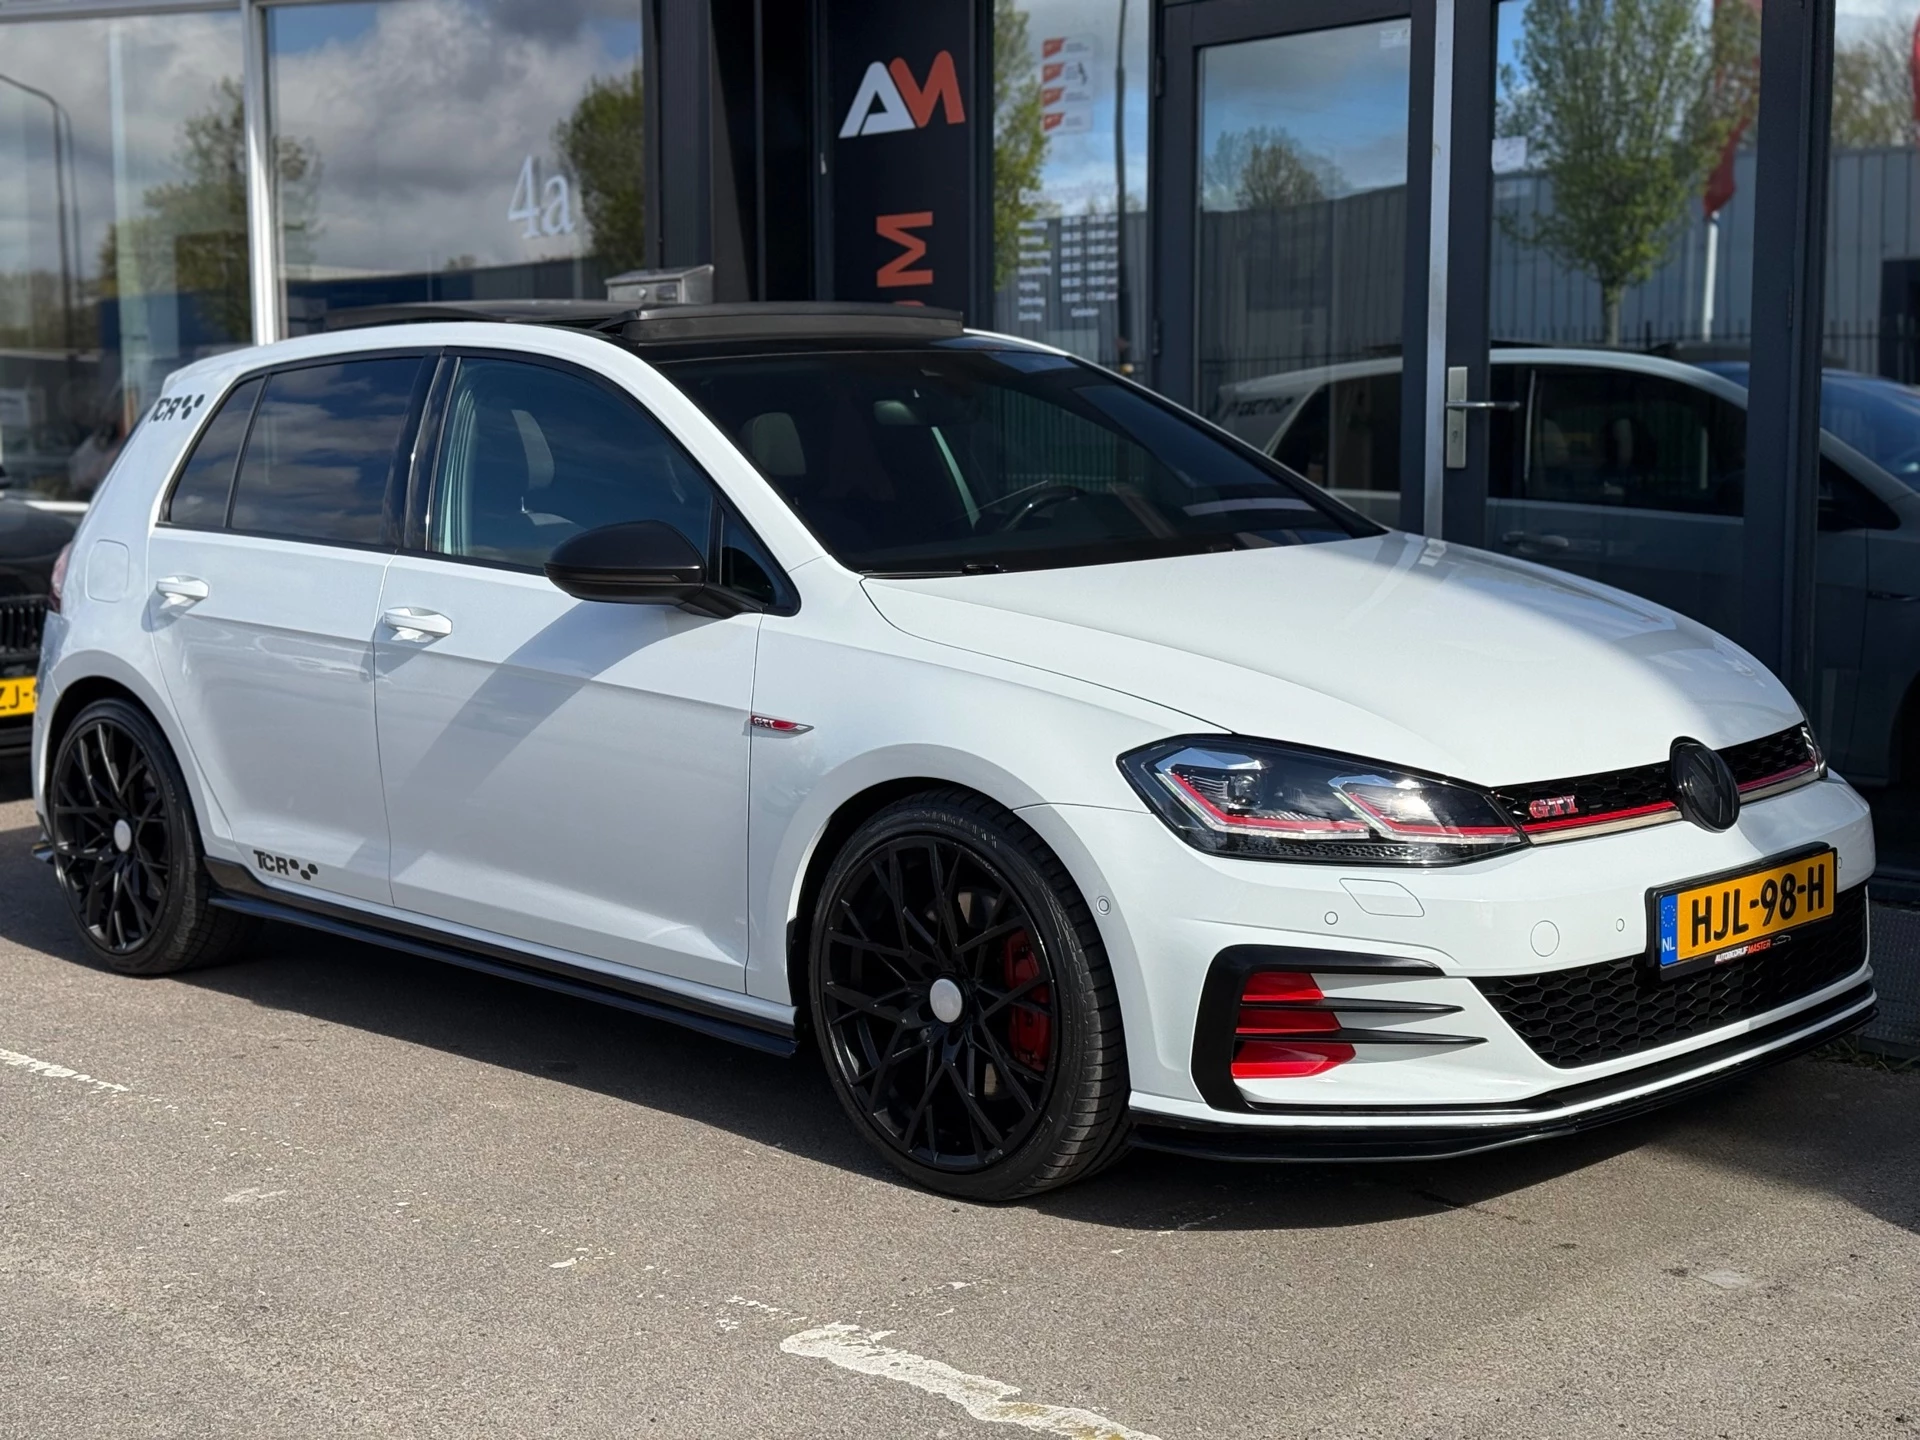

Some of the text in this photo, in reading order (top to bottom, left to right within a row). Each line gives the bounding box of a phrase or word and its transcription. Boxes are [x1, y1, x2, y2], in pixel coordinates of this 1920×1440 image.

[838, 50, 966, 138] AM
[508, 154, 576, 240] 4a
[875, 211, 933, 306] M
[1529, 795, 1579, 818] GTI
[253, 849, 290, 876] TCR
[1662, 936, 1676, 953] NL
[1692, 863, 1825, 948] HJL-98-H
